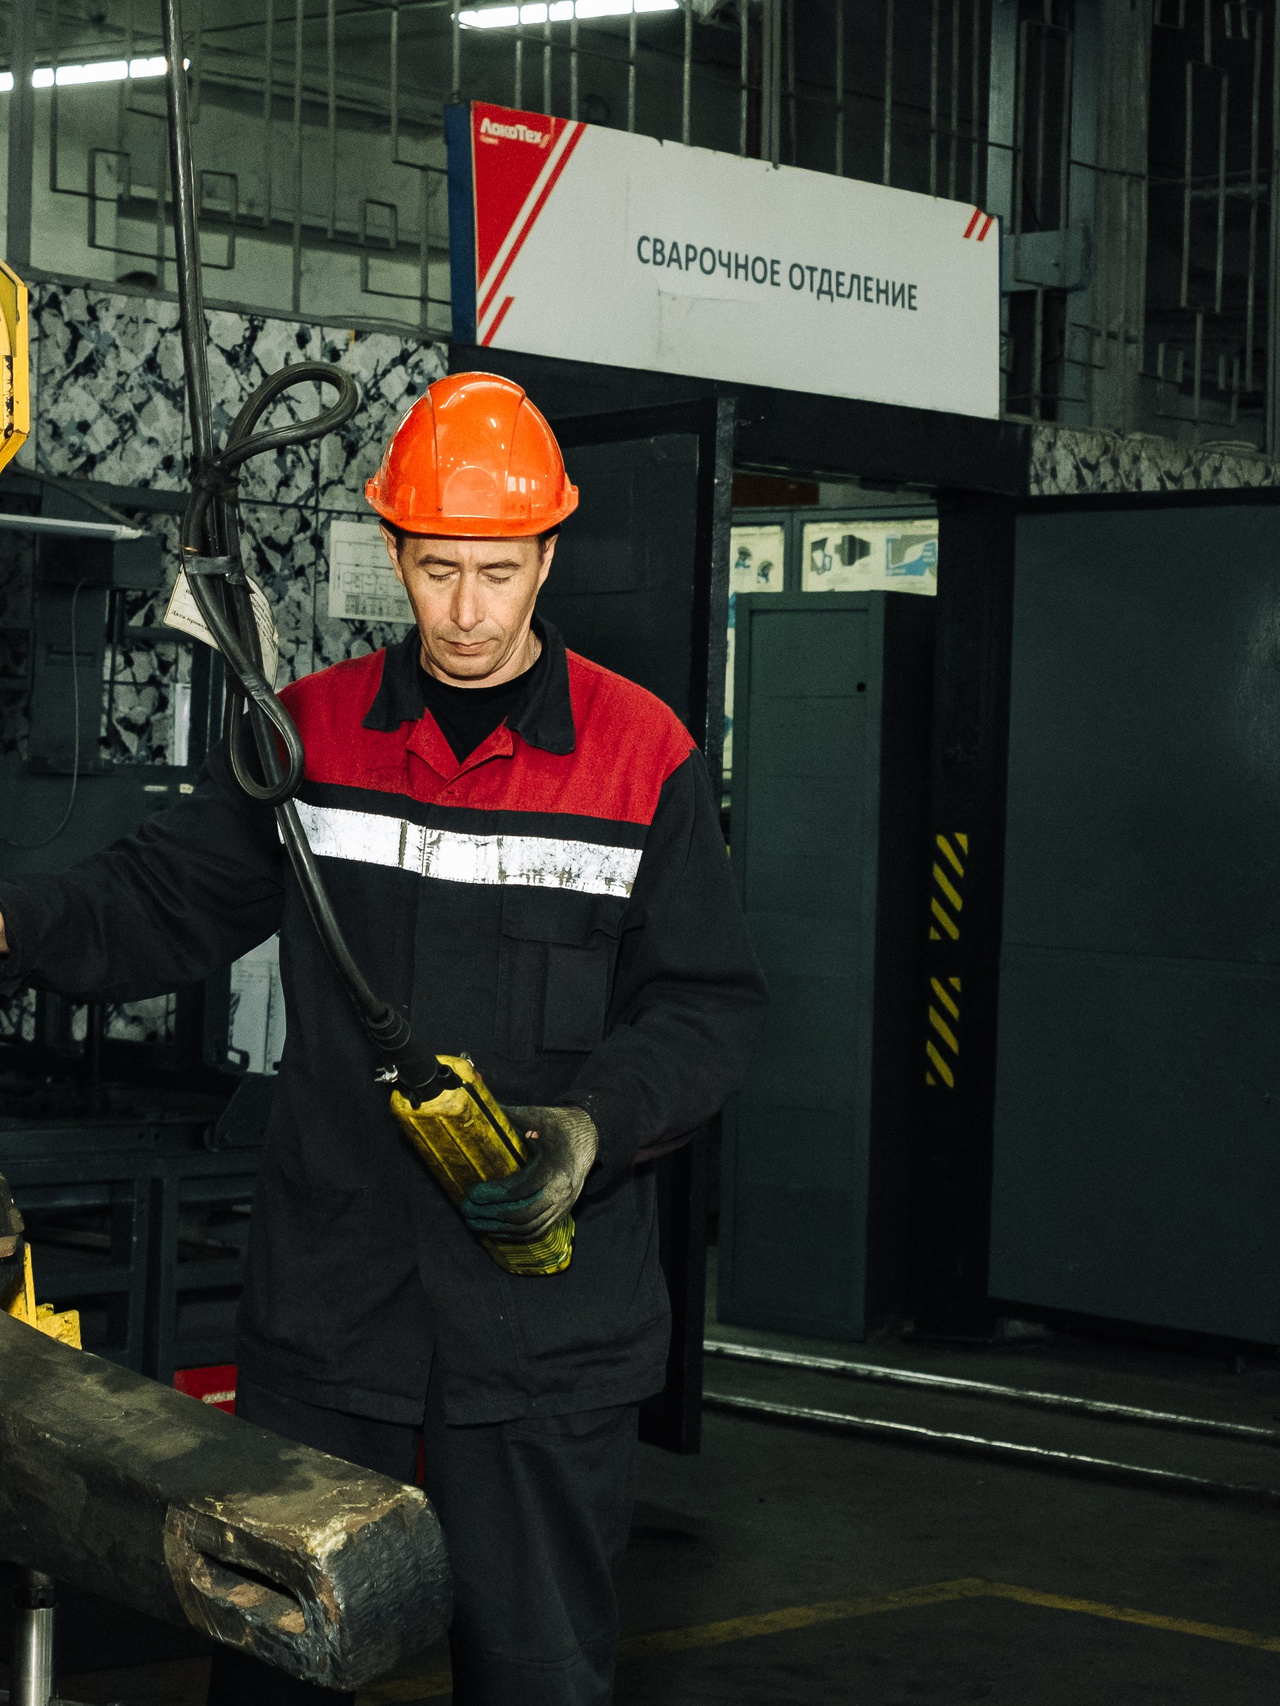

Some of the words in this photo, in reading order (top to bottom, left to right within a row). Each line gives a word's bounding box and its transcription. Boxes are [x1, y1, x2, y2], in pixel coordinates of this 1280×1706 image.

[480, 117, 543, 144] ЛокоТех
[636, 235, 781, 288] СВАРОЧНОЕ
[788, 262, 918, 311] ОТДЕЛЕНИЕ
